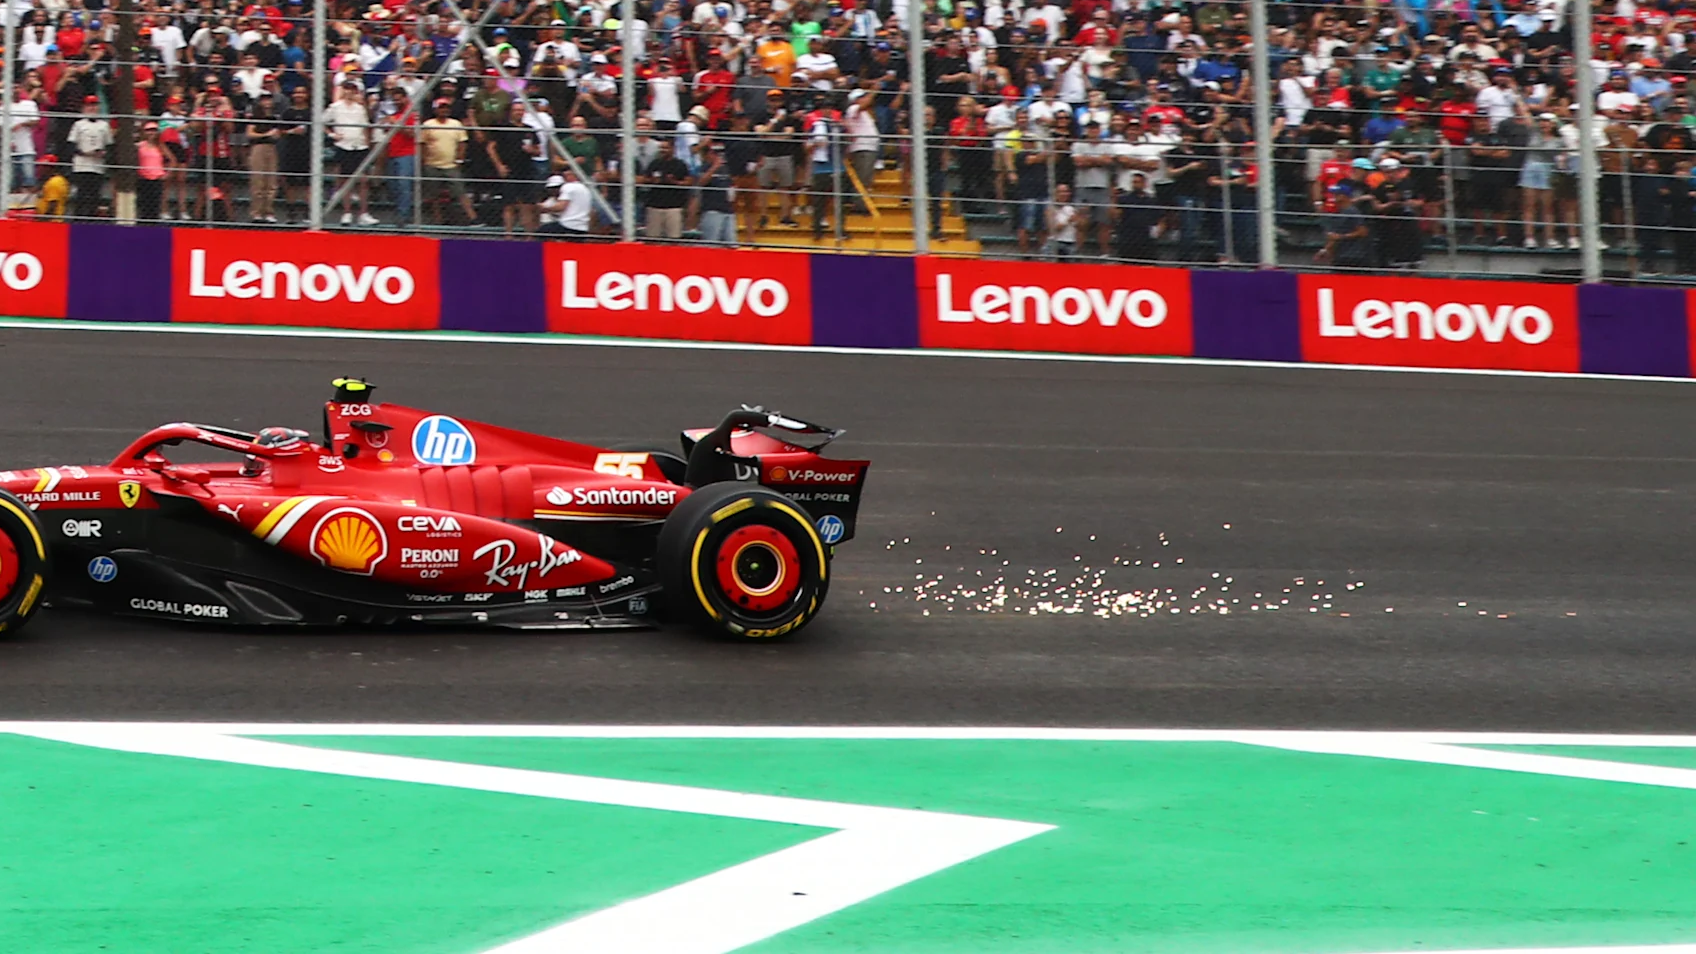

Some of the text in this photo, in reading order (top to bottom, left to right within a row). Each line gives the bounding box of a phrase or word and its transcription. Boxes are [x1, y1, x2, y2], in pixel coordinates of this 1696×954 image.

[189, 249, 414, 304] Lenovo
[562, 260, 789, 317] Lenovo
[936, 273, 1167, 328] Lenovo
[1318, 288, 1552, 344] Lenovo
[421, 416, 468, 465] hp
[318, 455, 343, 466] aws
[788, 469, 856, 482] V-Power
[16, 491, 101, 503] HARD MILLE
[573, 486, 677, 505] Santander
[814, 492, 850, 503] POKER
[397, 516, 462, 532] CEVA
[819, 515, 842, 543] hp
[400, 547, 459, 563] PERONI
[91, 557, 115, 582] hp
[524, 589, 548, 599] NGK
[130, 598, 229, 618] GLOBAL POKER
